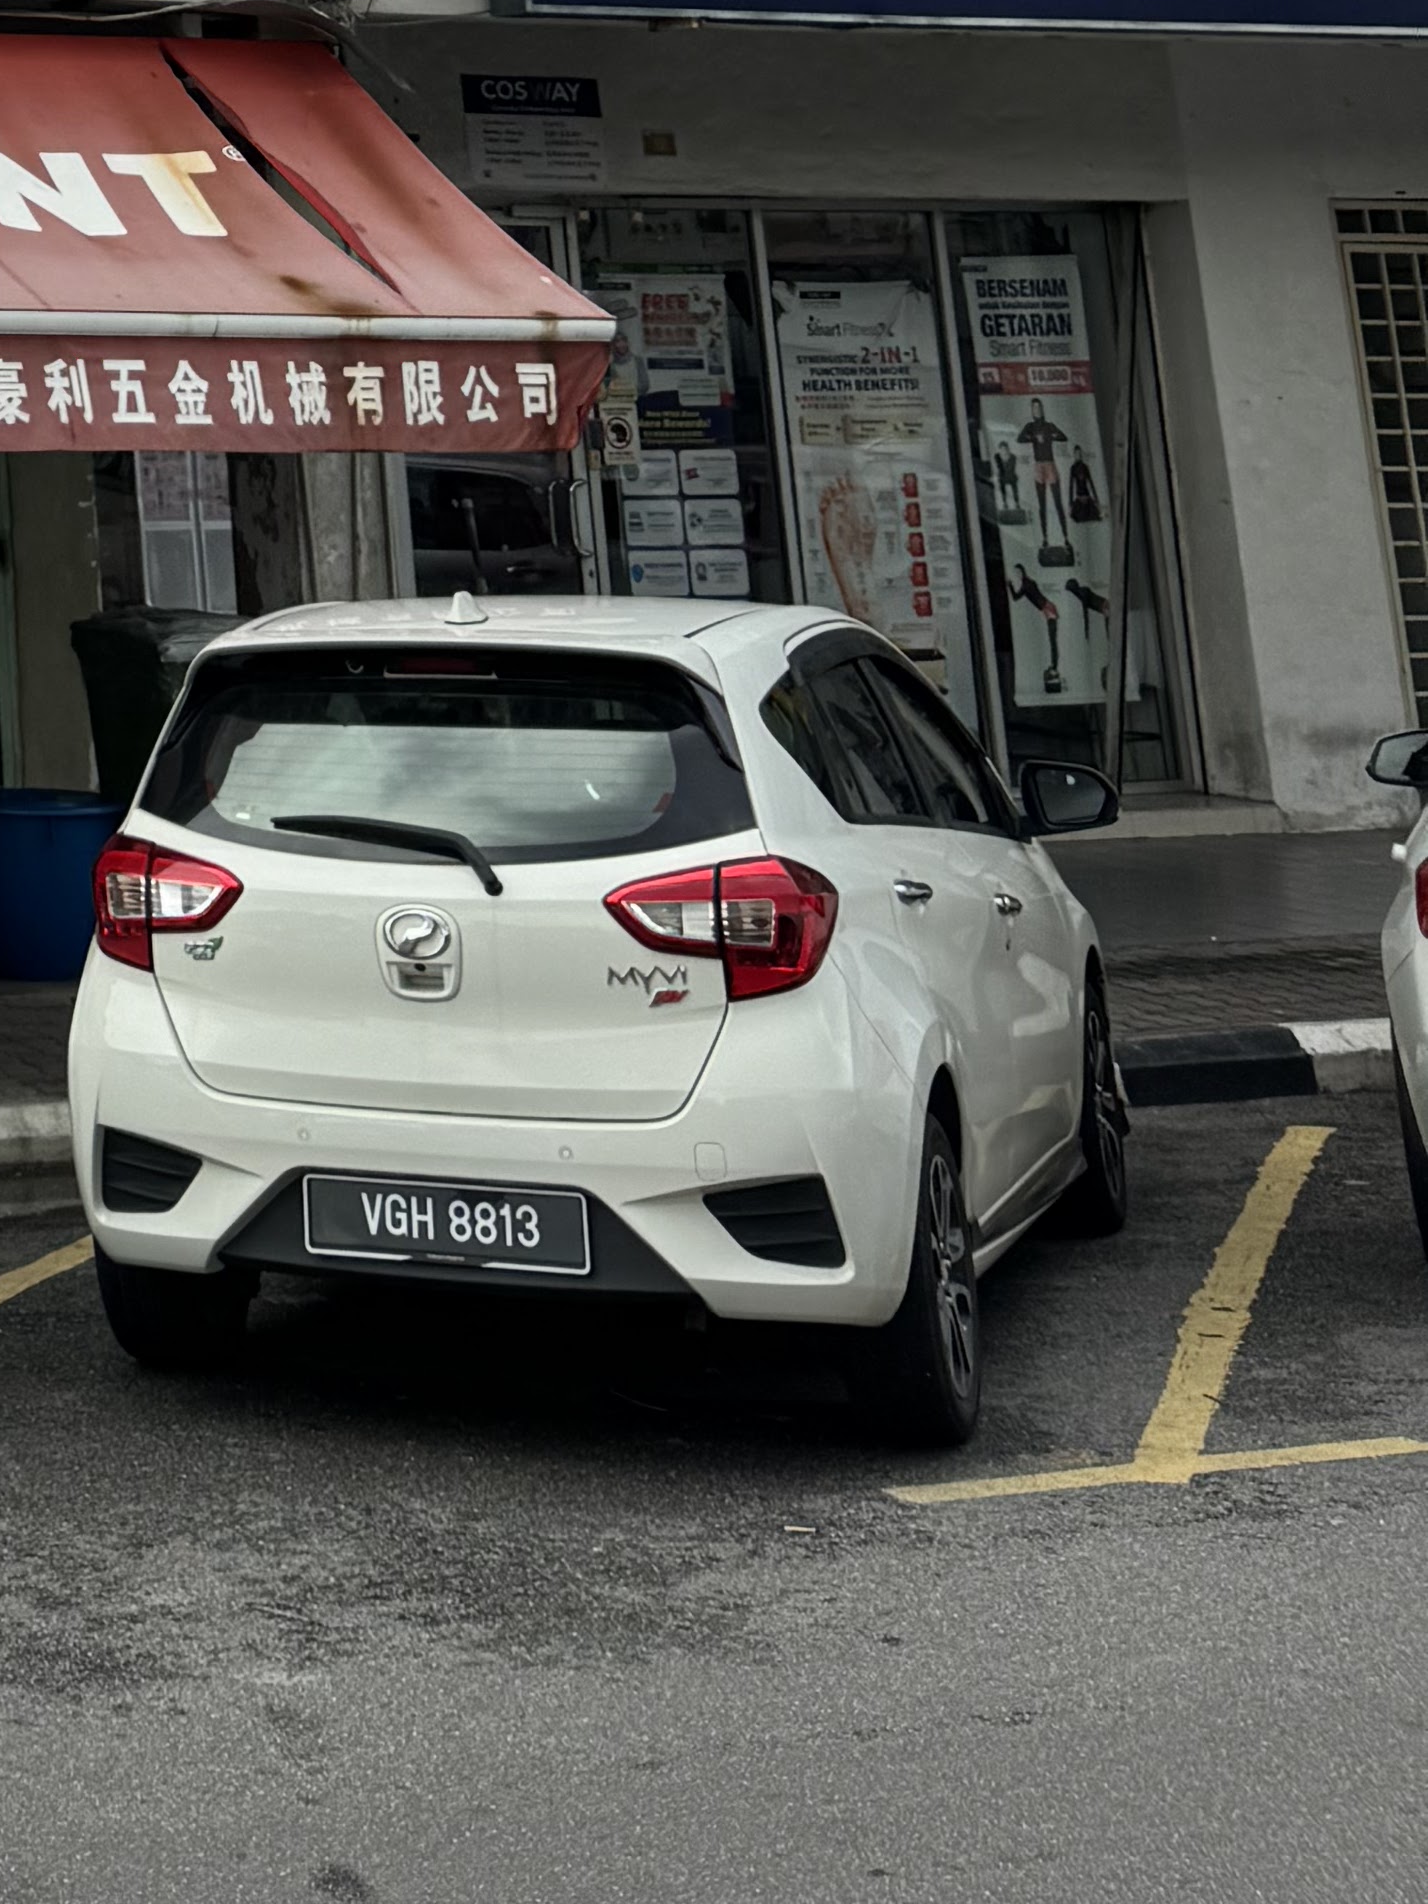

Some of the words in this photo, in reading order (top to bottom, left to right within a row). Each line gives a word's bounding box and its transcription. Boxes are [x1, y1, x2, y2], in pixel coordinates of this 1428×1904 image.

[480, 80, 581, 103] COSWAY
[975, 278, 1068, 298] BERSENAM
[980, 313, 1072, 337] GETARAN
[860, 345, 920, 364] 2-IN-1
[989, 340, 1026, 357] Smart
[859, 366, 878, 376] FOR
[802, 379, 852, 392] HEALTH
[361, 1192, 434, 1240] VGH
[448, 1200, 540, 1248] 8813
